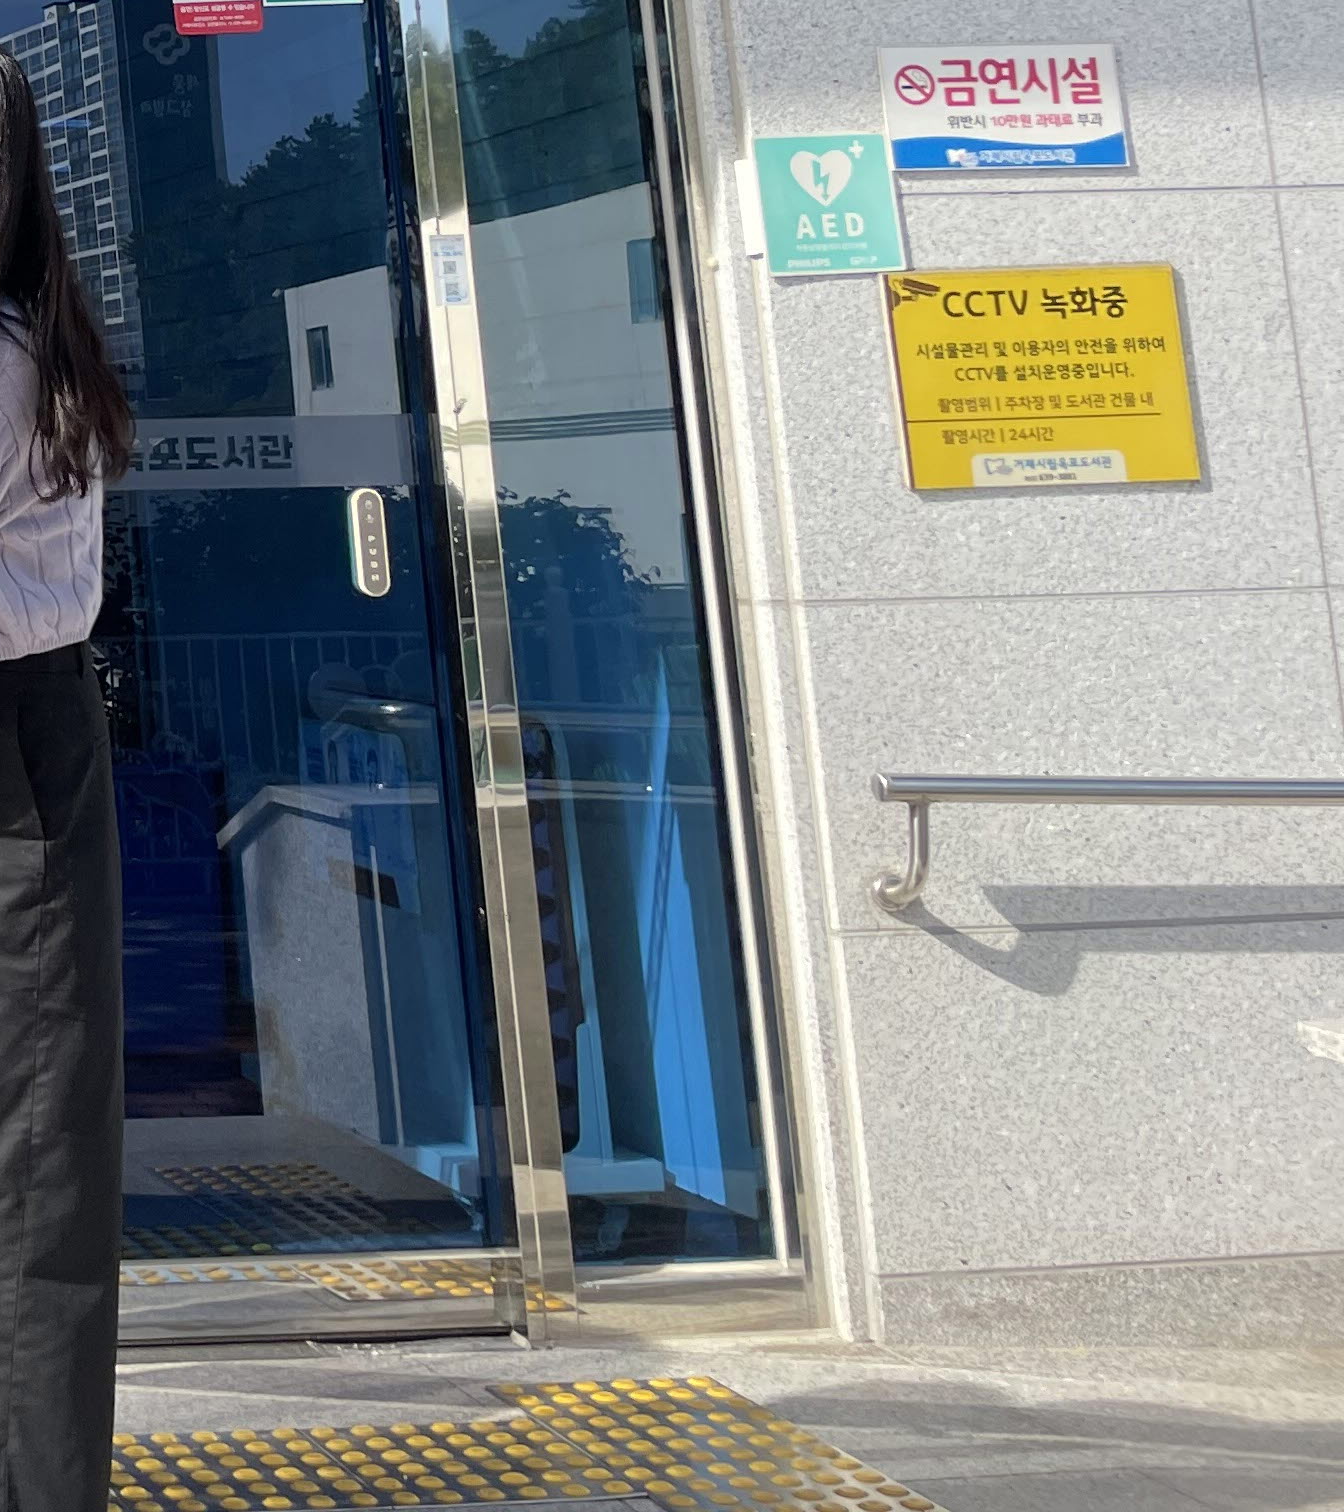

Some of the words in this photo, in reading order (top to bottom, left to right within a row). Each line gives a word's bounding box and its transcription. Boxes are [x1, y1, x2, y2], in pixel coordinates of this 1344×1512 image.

[937, 56, 1103, 107] 금연시설
[947, 114, 987, 129] 위반시
[990, 113, 1033, 128] 10만원
[1036, 113, 1073, 128] 과태료
[1077, 113, 1103, 127] 부과
[796, 212, 864, 240] AED
[943, 289, 1028, 317] CCTV
[1040, 286, 1128, 319] 녹화중
[916, 342, 988, 359] 시설물관리
[993, 342, 1008, 357] 및
[1013, 340, 1070, 356] 이용자의
[1076, 338, 1118, 355] 안전을
[1123, 336, 1165, 353] 위하여
[955, 365, 1008, 382] CCTV를
[1013, 362, 1135, 381] 설치운영중입니다.
[937, 397, 991, 414] 촬영범위
[1004, 396, 1045, 411] 주차장
[1049, 394, 1062, 409] 및
[1066, 393, 1106, 409] 도서관
[1110, 392, 1136, 407] 건물
[1140, 391, 1154, 406] 내
[941, 428, 995, 445] 촬영시간
[1009, 426, 1054, 442] 24시간
[1013, 456, 1112, 471] 거제시립옥포도서관
